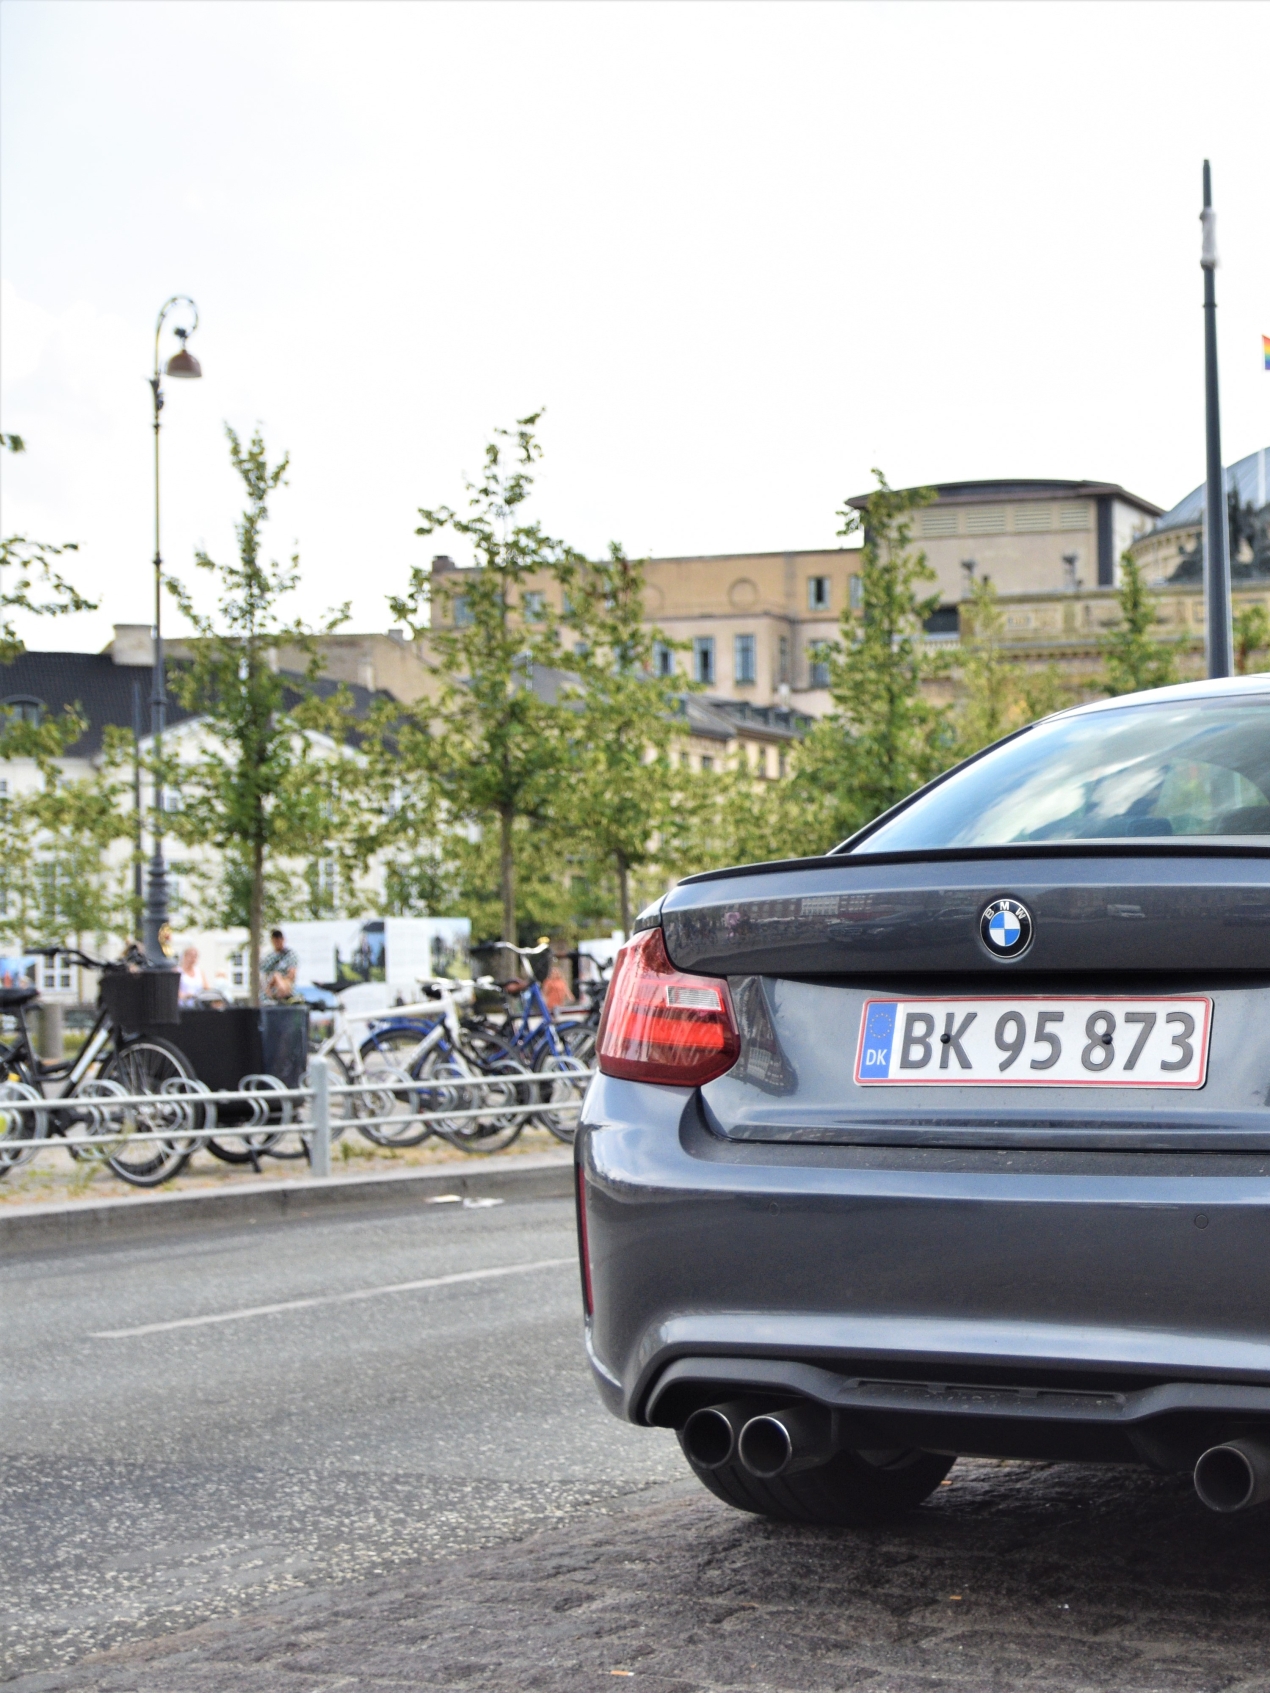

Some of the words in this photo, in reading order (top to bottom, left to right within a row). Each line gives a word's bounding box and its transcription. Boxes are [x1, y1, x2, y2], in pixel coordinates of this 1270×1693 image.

[984, 901, 1027, 920] BMW
[899, 1012, 978, 1069] BK
[994, 1010, 1065, 1072] 95
[1080, 1010, 1196, 1072] 873
[865, 1048, 887, 1066] DK
